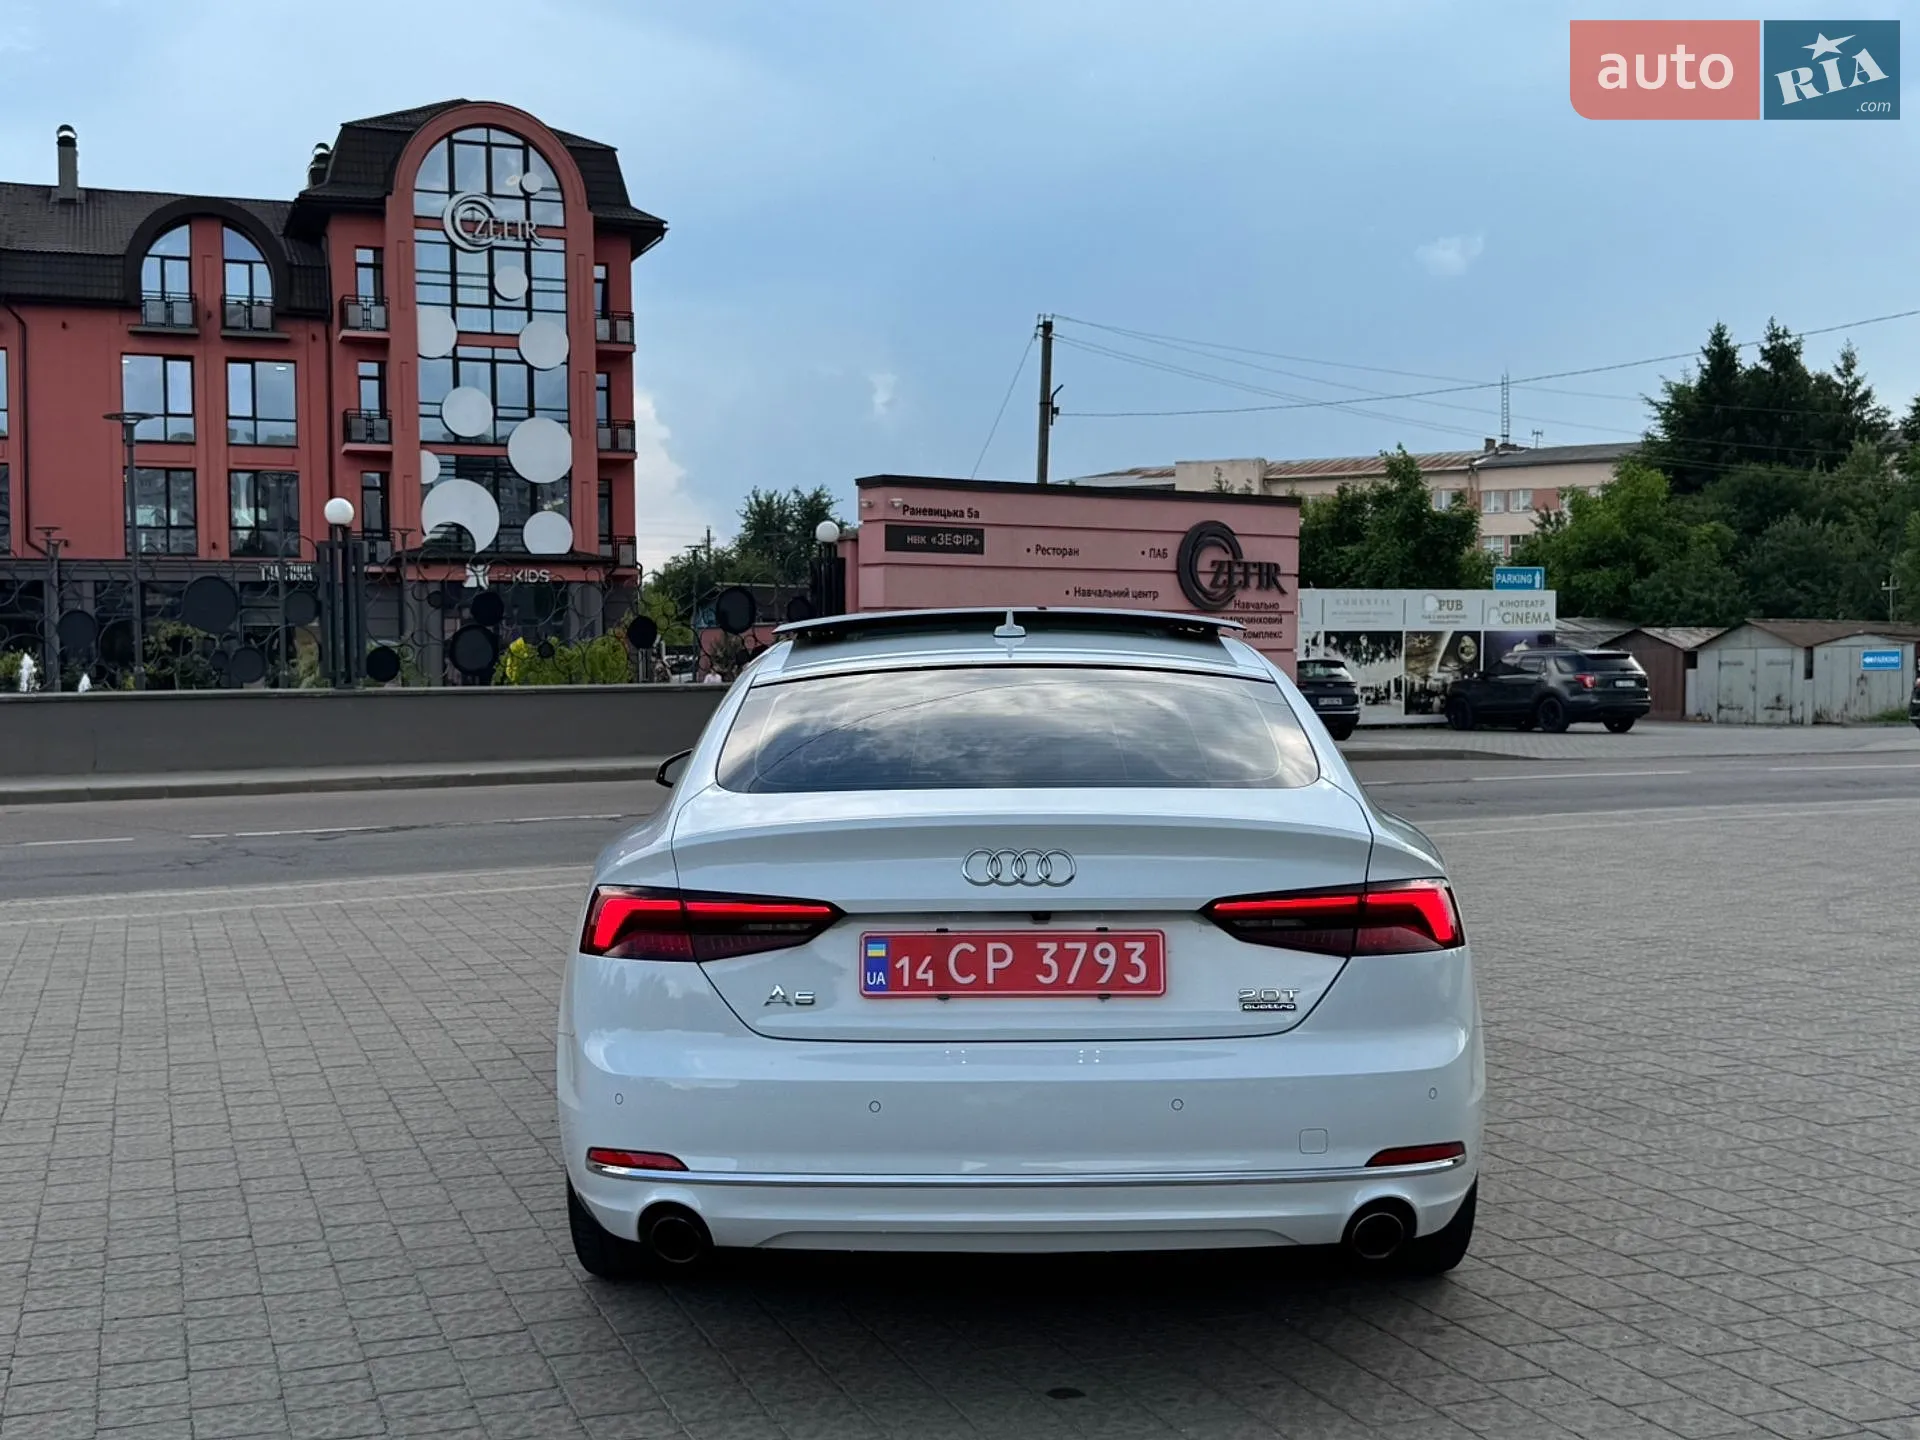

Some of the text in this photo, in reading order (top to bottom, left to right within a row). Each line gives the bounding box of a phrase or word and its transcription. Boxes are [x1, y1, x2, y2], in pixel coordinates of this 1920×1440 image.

[474, 215, 544, 246] ZEFIR
[902, 504, 980, 519] Раневицька 5а
[1035, 543, 1080, 559] Ресторан
[1149, 547, 1168, 559] ПАБ
[1209, 559, 1288, 595] ZEFIR
[1495, 573, 1533, 585] PARKING
[1073, 586, 1159, 601] Навчальний центр
[1438, 599, 1463, 612] PUB
[1501, 611, 1552, 625] CINEMA
[1242, 630, 1284, 640] комплекс
[895, 941, 1148, 987] 14 CP 3793
[866, 971, 886, 985] UA
[763, 984, 816, 1006] A5
